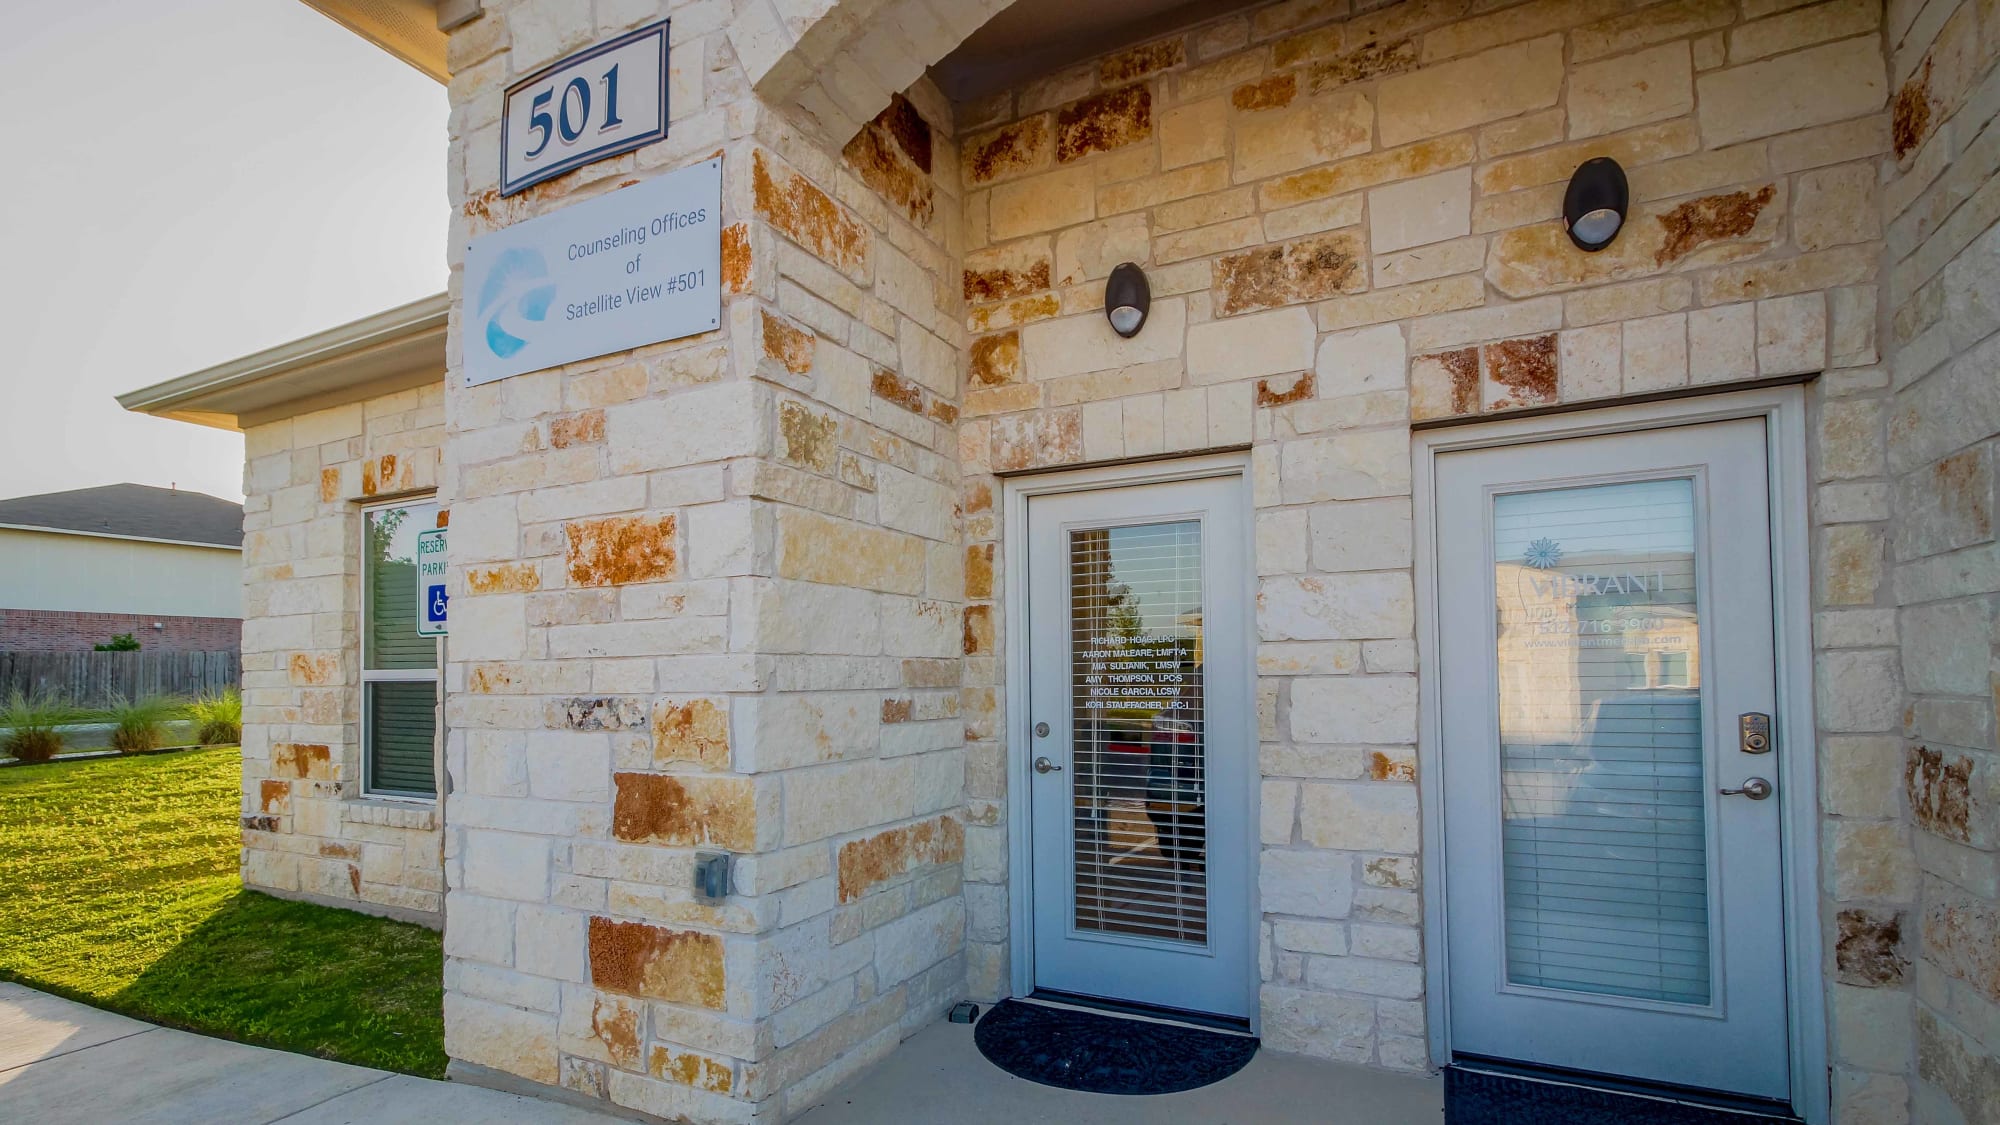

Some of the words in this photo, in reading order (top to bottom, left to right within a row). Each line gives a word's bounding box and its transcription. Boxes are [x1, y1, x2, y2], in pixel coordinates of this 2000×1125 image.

[525, 62, 623, 157] 501
[568, 226, 646, 260] Counseling
[651, 208, 706, 236] Offices
[626, 253, 642, 274] of
[566, 294, 622, 320] Satellite
[626, 284, 661, 305] View
[667, 268, 705, 295] #501
[1529, 570, 1665, 599] VIBRANT
[1578, 619, 1611, 633] 716
[1090, 636, 1127, 645] RICHARD
[1158, 634, 1175, 643] LPC
[1082, 649, 1111, 658] AARON
[1092, 662, 1107, 671] MIA
[1155, 661, 1181, 669] LMSW
[1085, 675, 1103, 684] AMY
[1108, 674, 1155, 684] THOMPSON,
[1090, 687, 1120, 696] NICOLE
[1121, 687, 1156, 697] GARCIA,
[1156, 687, 1181, 696] LCSW
[1085, 701, 1104, 709] KORI
